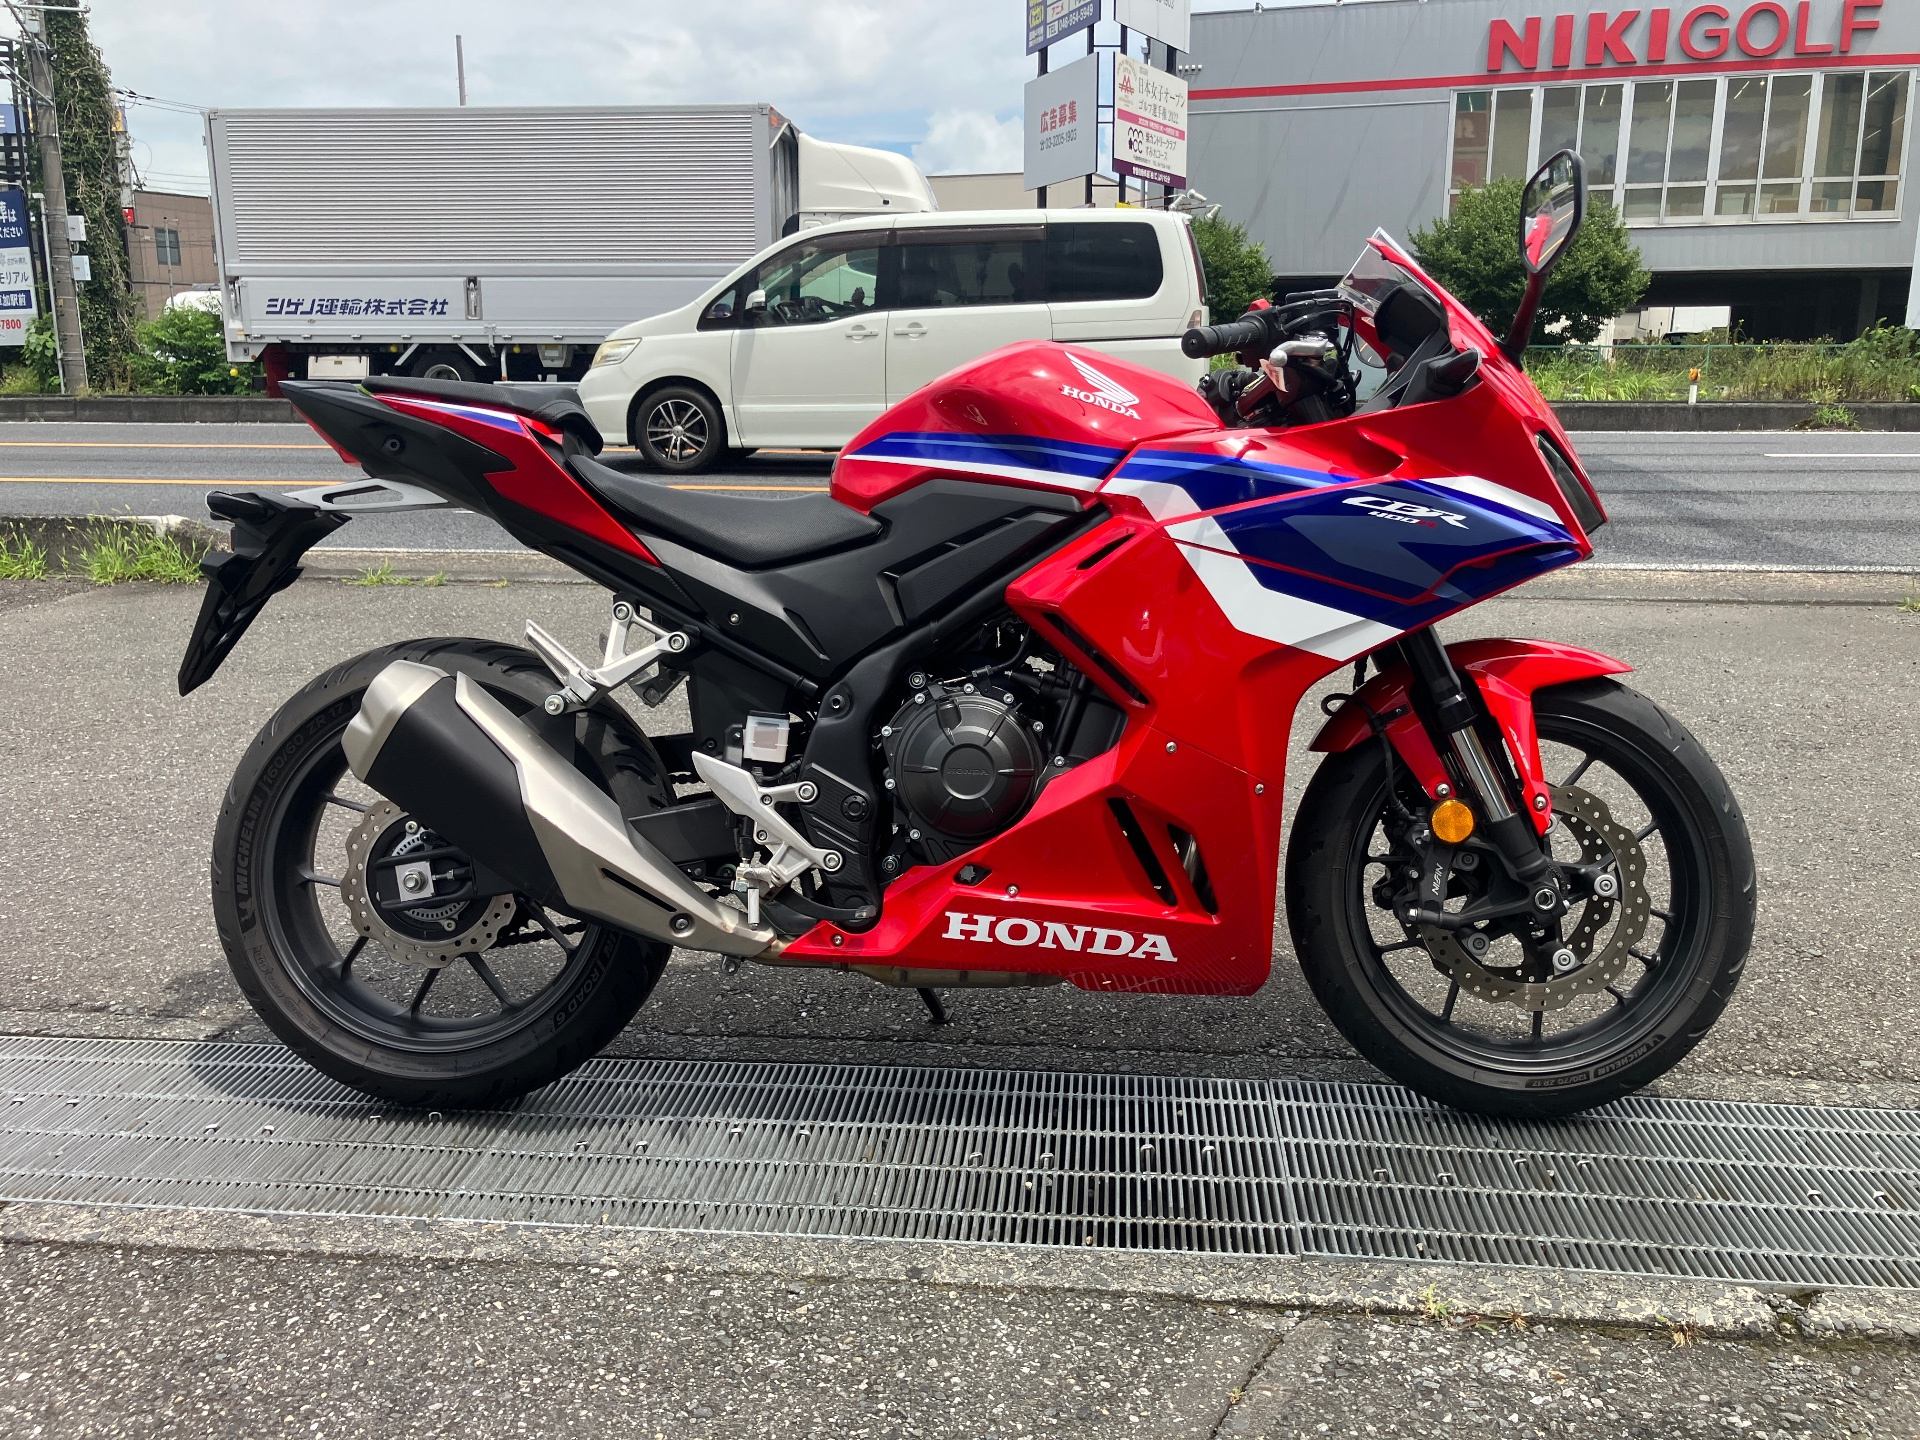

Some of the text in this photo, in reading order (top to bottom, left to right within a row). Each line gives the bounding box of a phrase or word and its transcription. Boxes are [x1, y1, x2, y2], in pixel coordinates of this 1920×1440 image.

[1048, 24, 1057, 36] TEL
[1040, 99, 1077, 133] 広告募集
[1061, 384, 1142, 420] HONDA
[1342, 496, 1470, 530] CBR
[947, 768, 989, 776] HONDA
[236, 701, 345, 895] MICHELIN 160/60 ZR 17
[942, 911, 1178, 963] HONDA
[556, 968, 600, 1025] ROAD 6
[1597, 1045, 1648, 1076] MICHELIN
